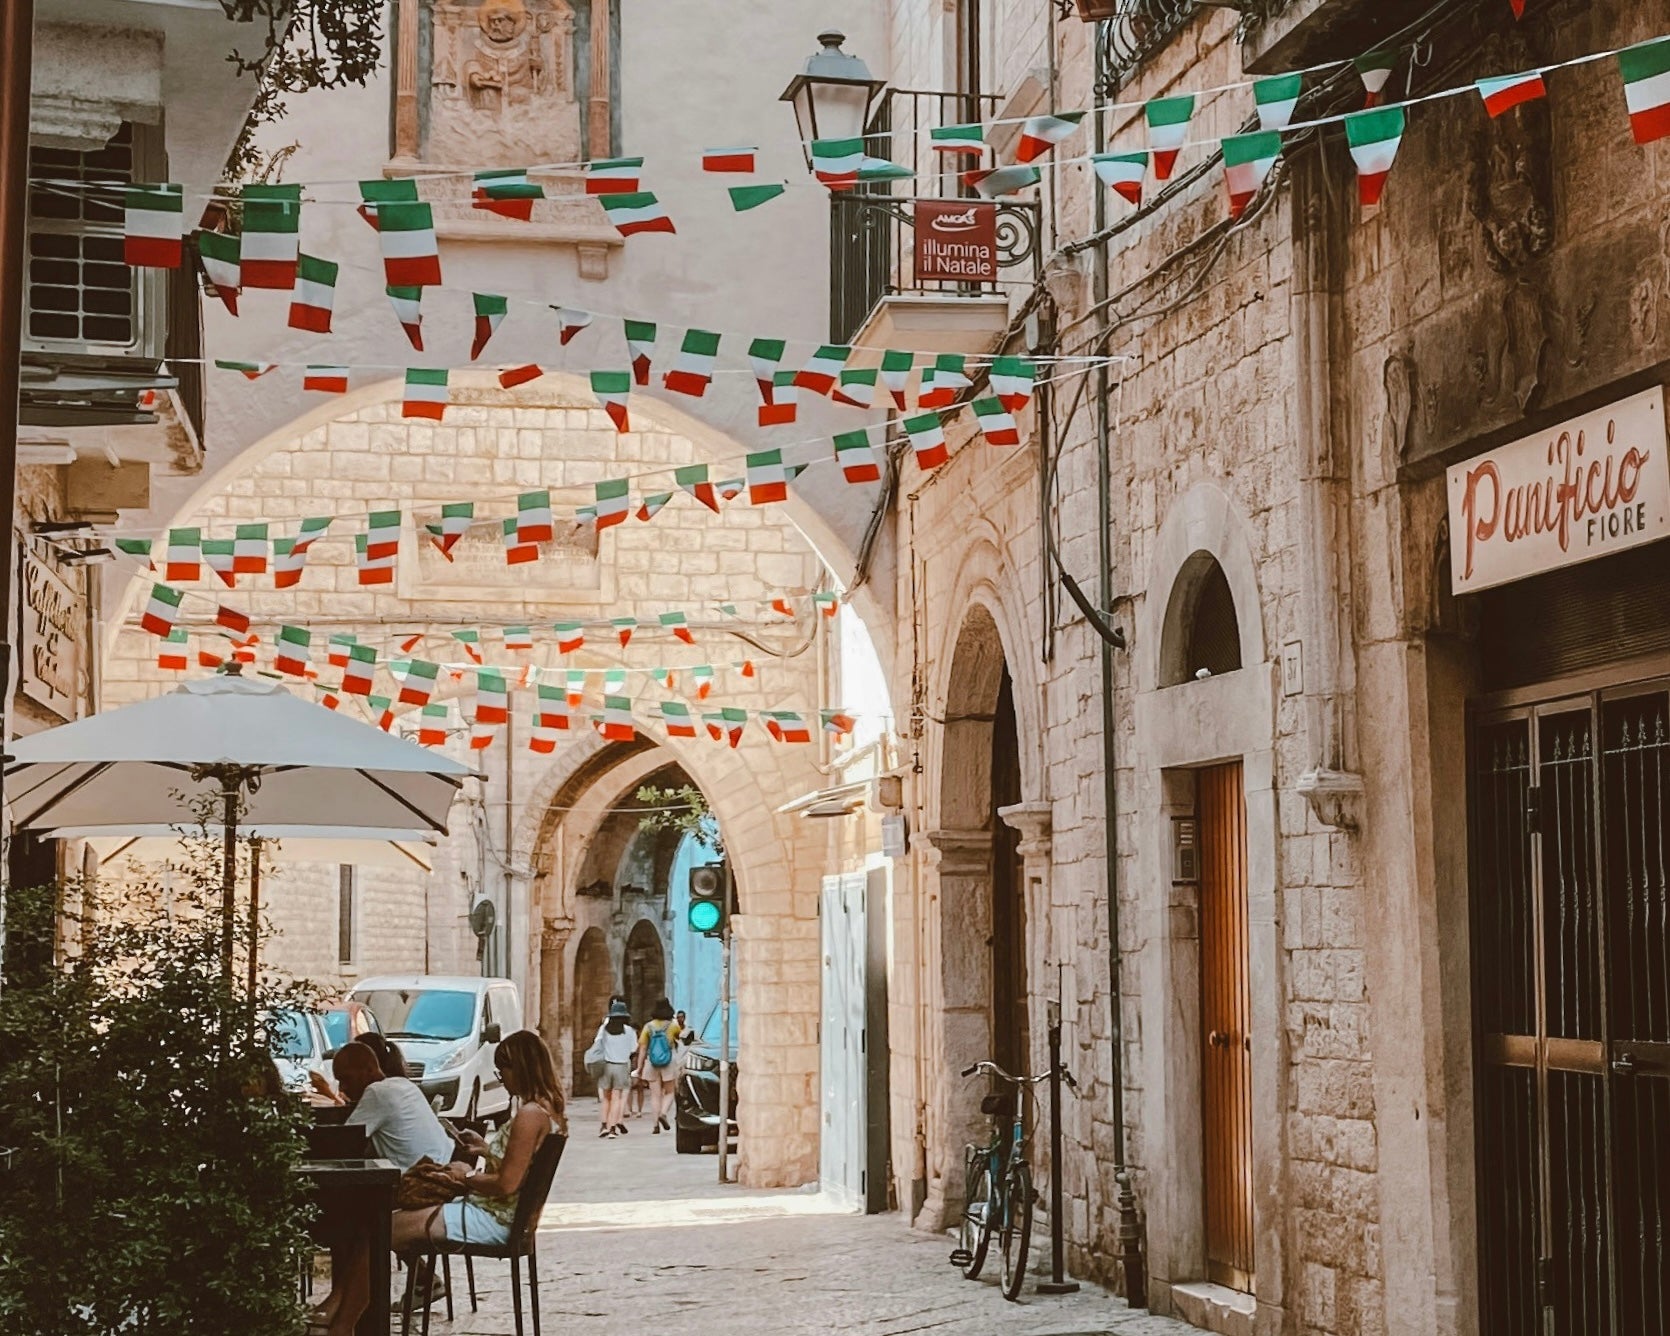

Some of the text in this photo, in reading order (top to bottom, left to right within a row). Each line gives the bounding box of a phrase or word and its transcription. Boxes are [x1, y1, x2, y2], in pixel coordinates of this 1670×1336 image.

[923, 239, 990, 259] illumina
[923, 256, 991, 275] il Natale
[1462, 419, 1650, 580] Panificio
[1587, 502, 1646, 546] FIORE
